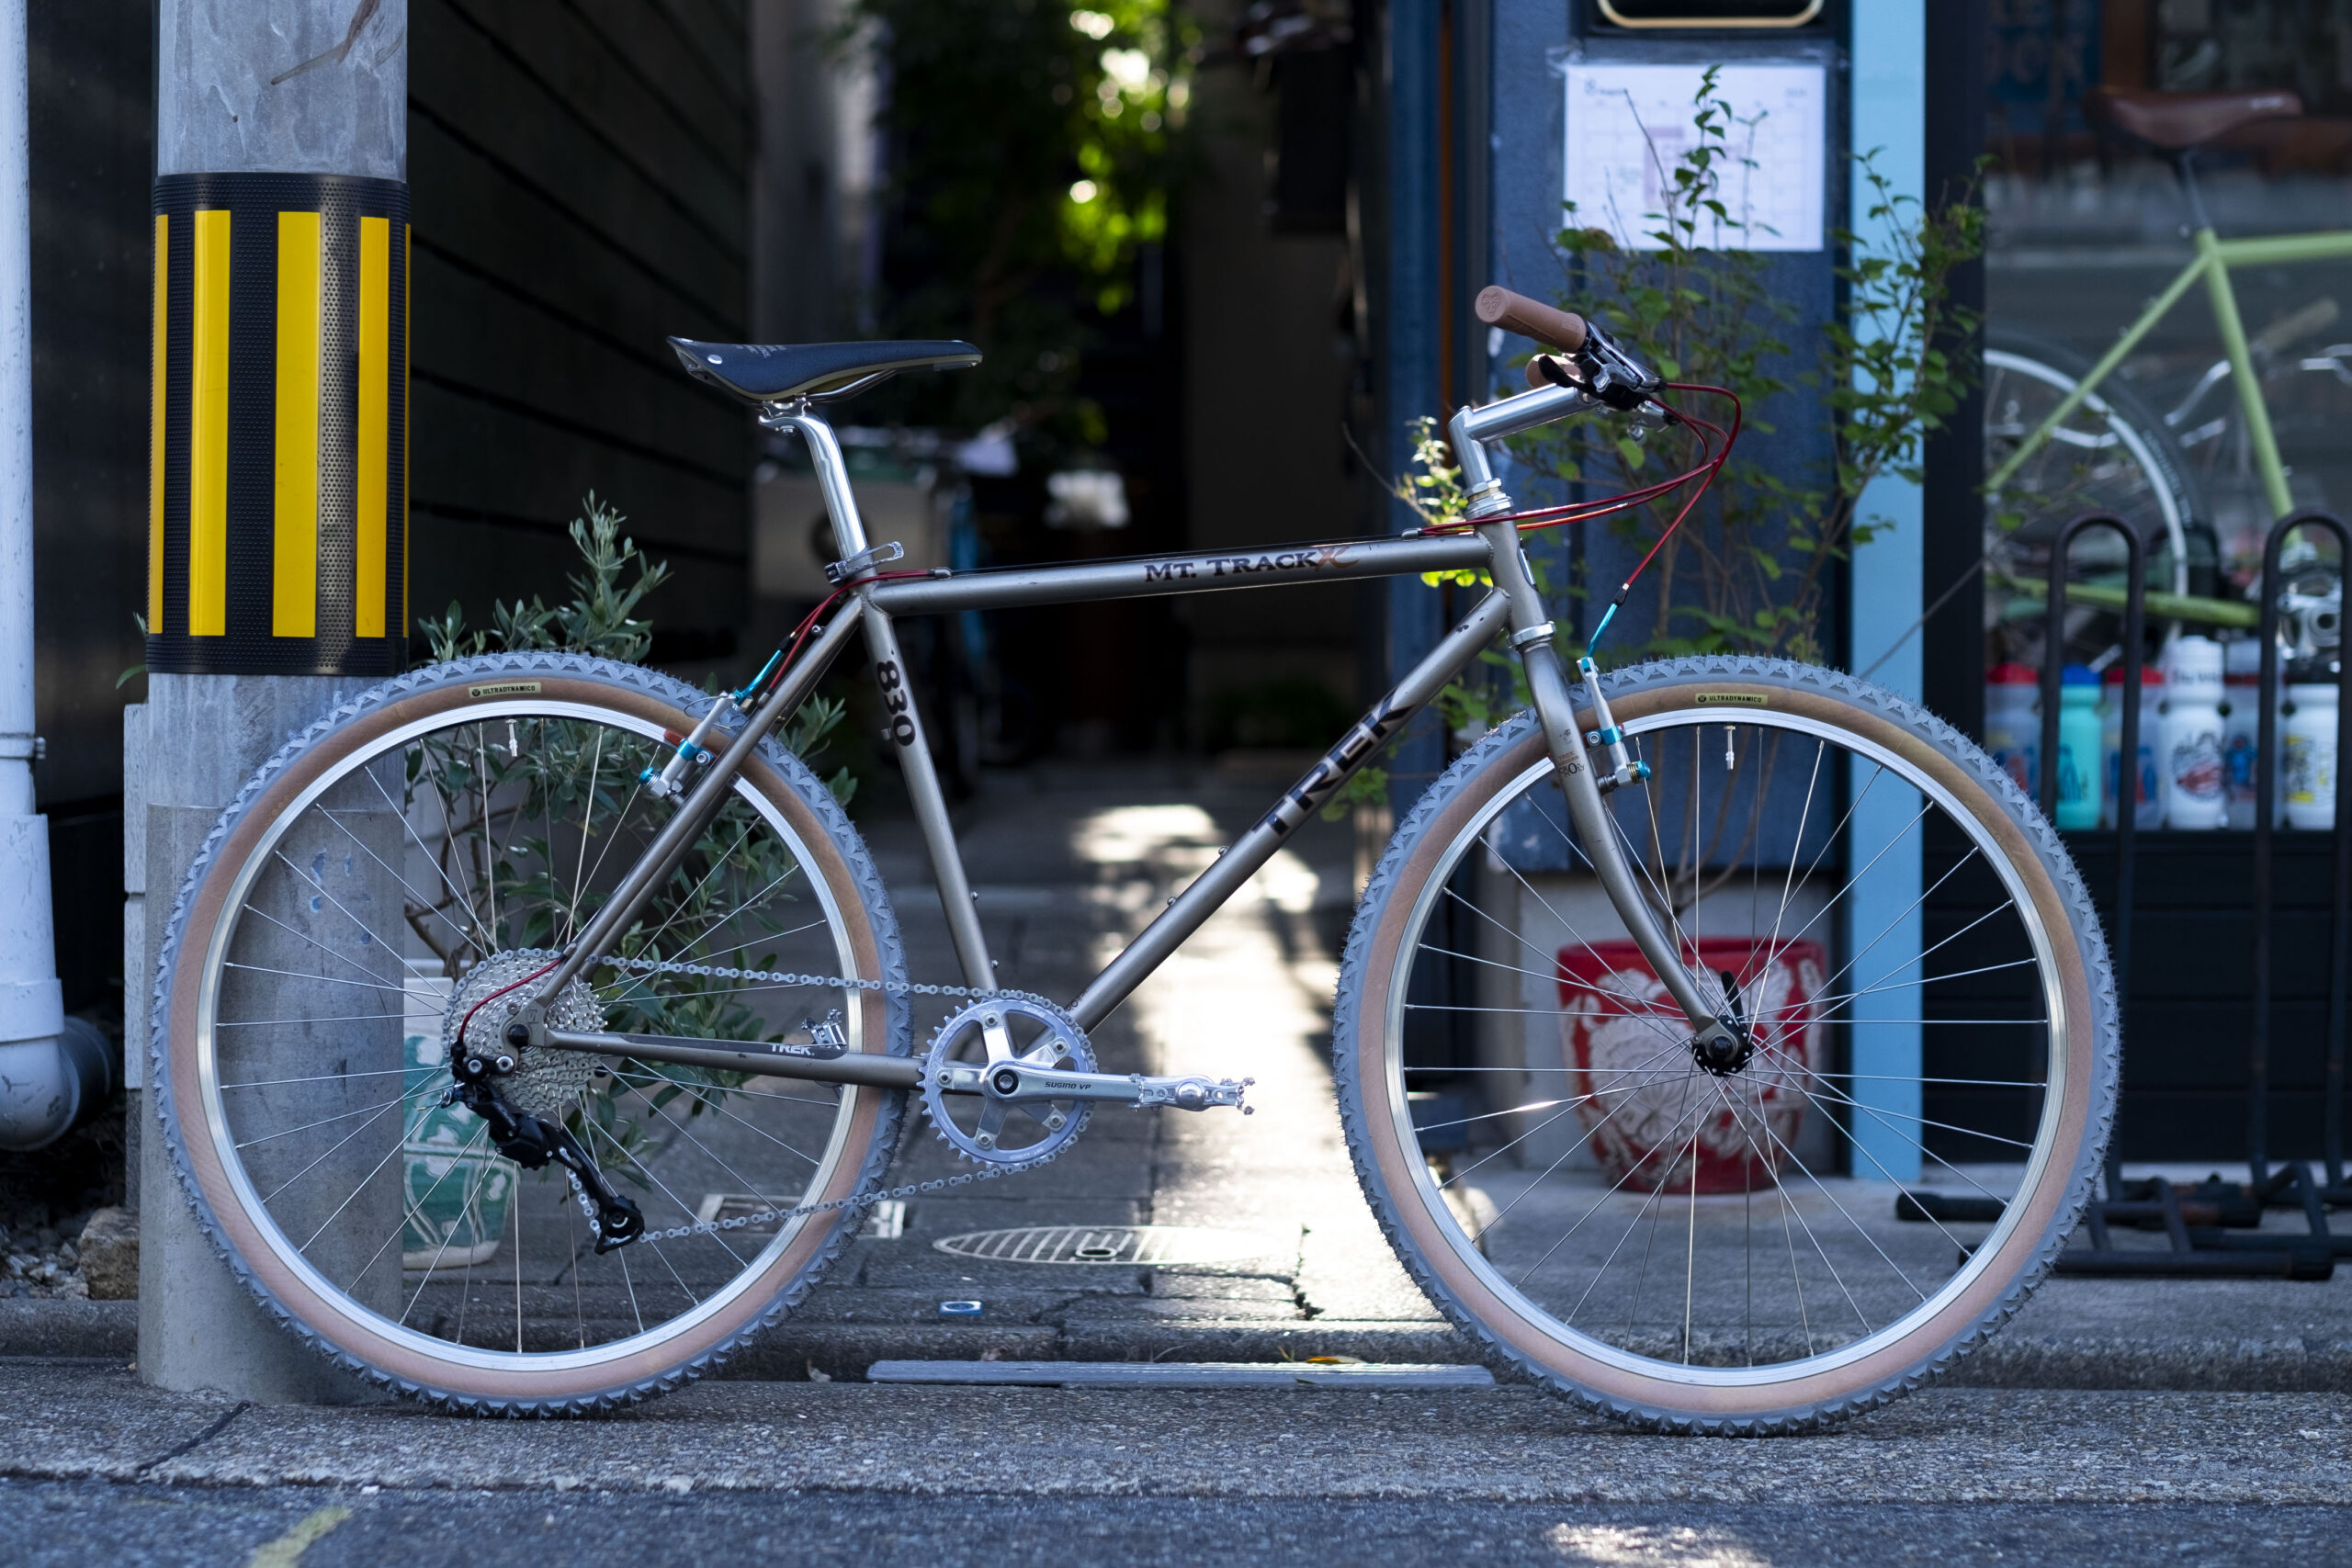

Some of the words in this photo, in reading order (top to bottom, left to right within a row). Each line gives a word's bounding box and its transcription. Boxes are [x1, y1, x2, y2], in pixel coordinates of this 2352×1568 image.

[1145, 562, 1197, 582] MT.
[1206, 551, 1319, 577] TRACK
[482, 685, 536, 694] ULTRADYNAMICO
[876, 660, 916, 747] 830
[1709, 694, 1762, 704] ULTRADYNAMICO
[1250, 685, 1418, 837] TREK
[769, 1043, 812, 1056] TREK
[1045, 1081, 1077, 1089] SUGINO
